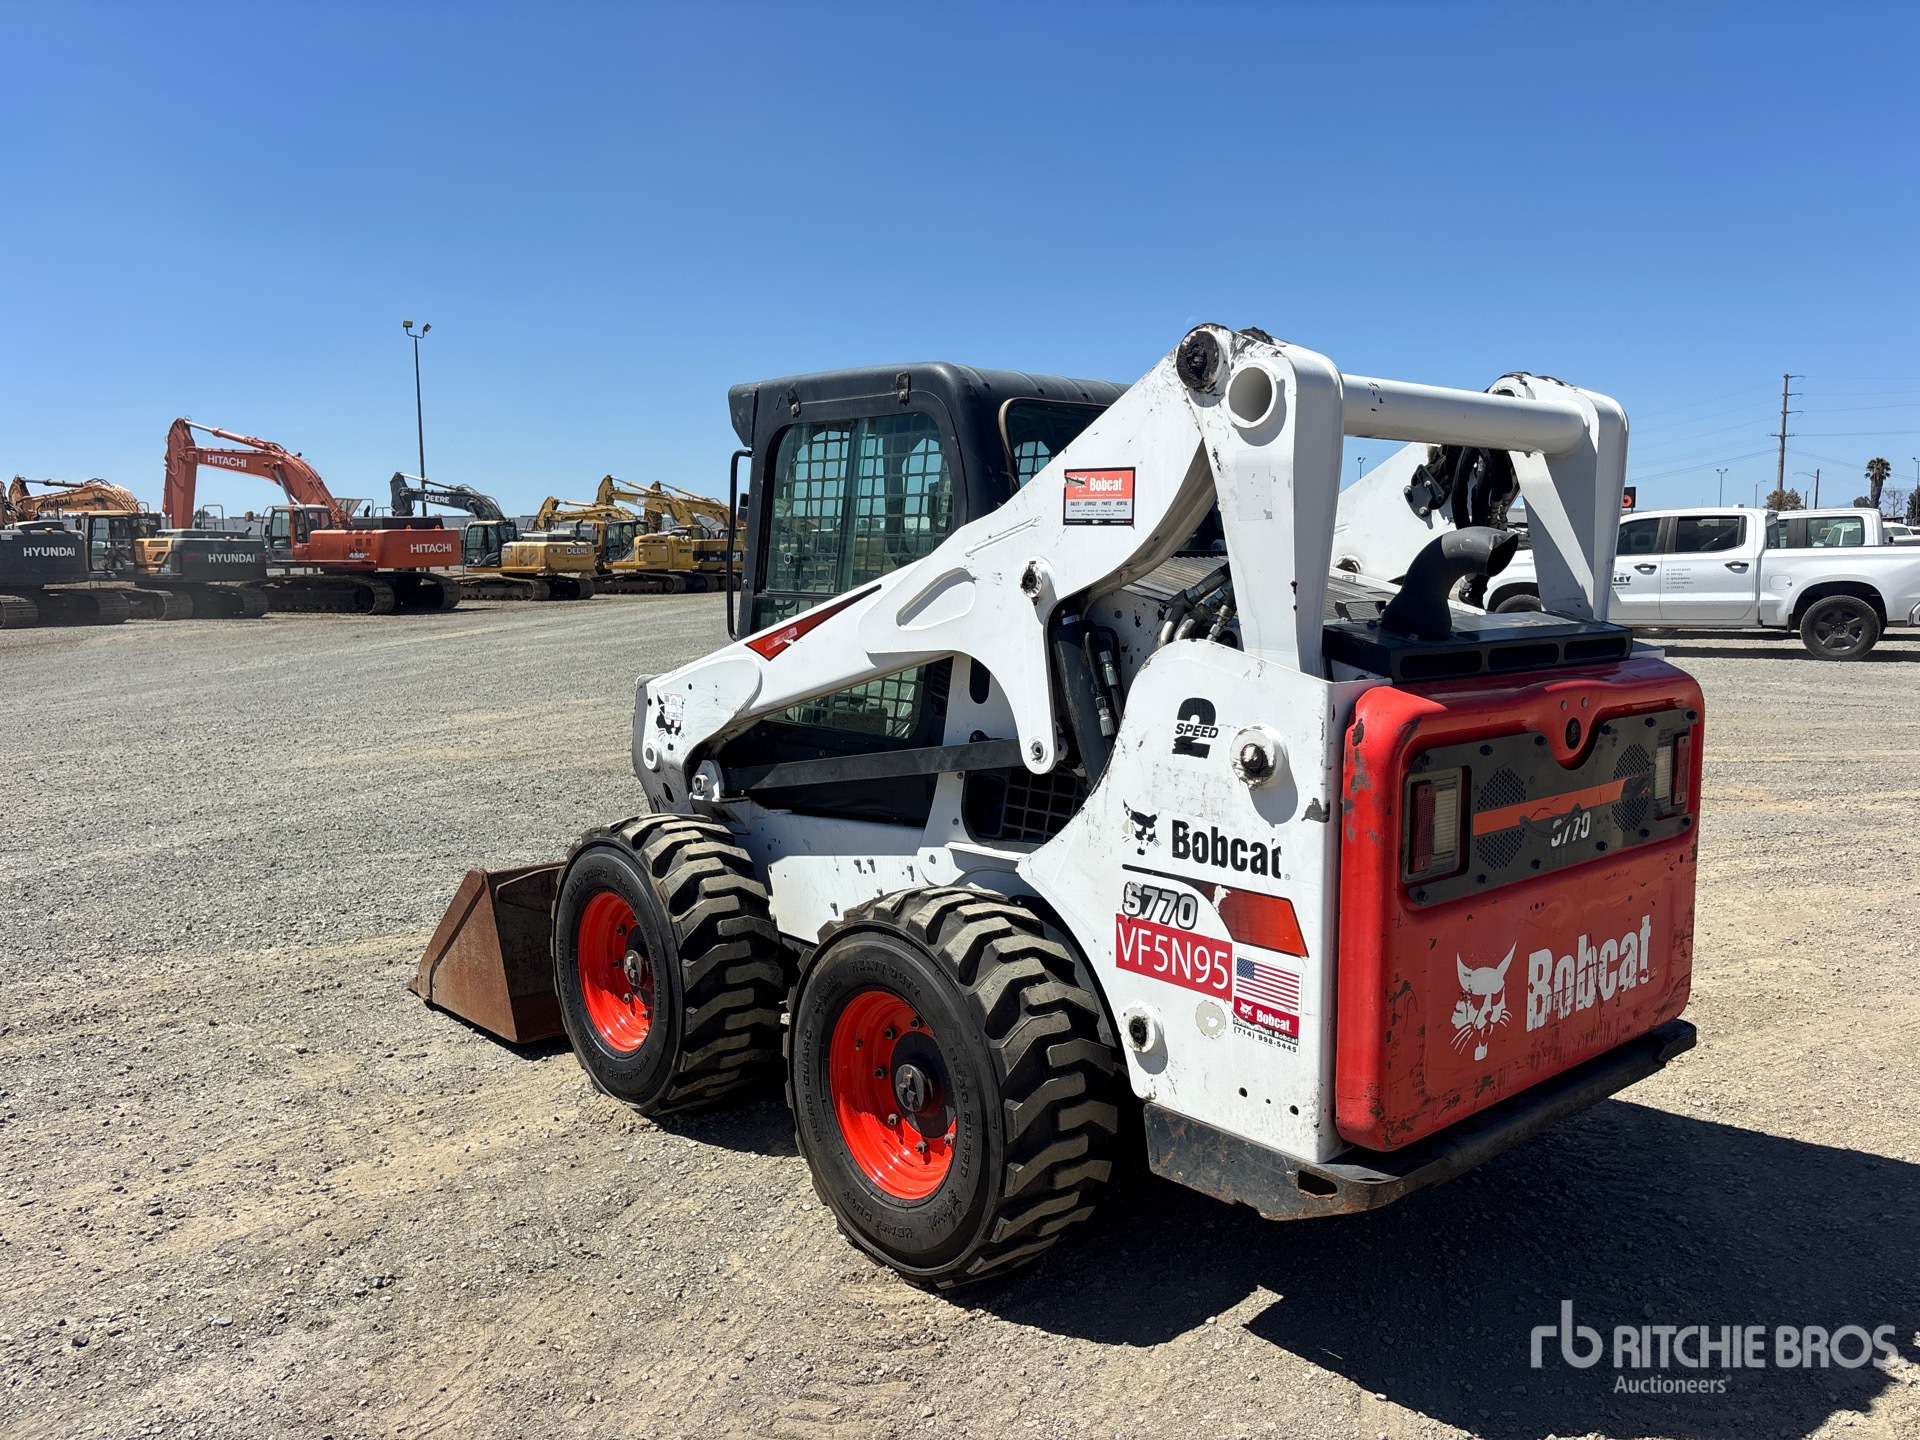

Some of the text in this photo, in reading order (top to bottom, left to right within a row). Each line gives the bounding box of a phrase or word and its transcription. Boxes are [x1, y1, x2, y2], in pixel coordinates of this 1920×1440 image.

[207, 454, 247, 468] HITACHI
[1089, 477, 1123, 492] Bobcat
[424, 493, 450, 504] DEERE
[23, 547, 76, 557] HYUNDAI
[208, 553, 256, 563] HYUNDAI
[410, 543, 452, 554] HITACHI
[1172, 697, 1217, 759] 2
[1174, 722, 1219, 740] SPEED
[1172, 819, 1282, 880] Bobcat
[1122, 880, 1199, 931] S770
[1117, 922, 1229, 990] VF5N95
[1526, 914, 1652, 1033] Bobcat
[1256, 1009, 1291, 1032] Bobcat
[1233, 1026, 1255, 1040] (714)
[1258, 1034, 1297, 1053] 998-5445
